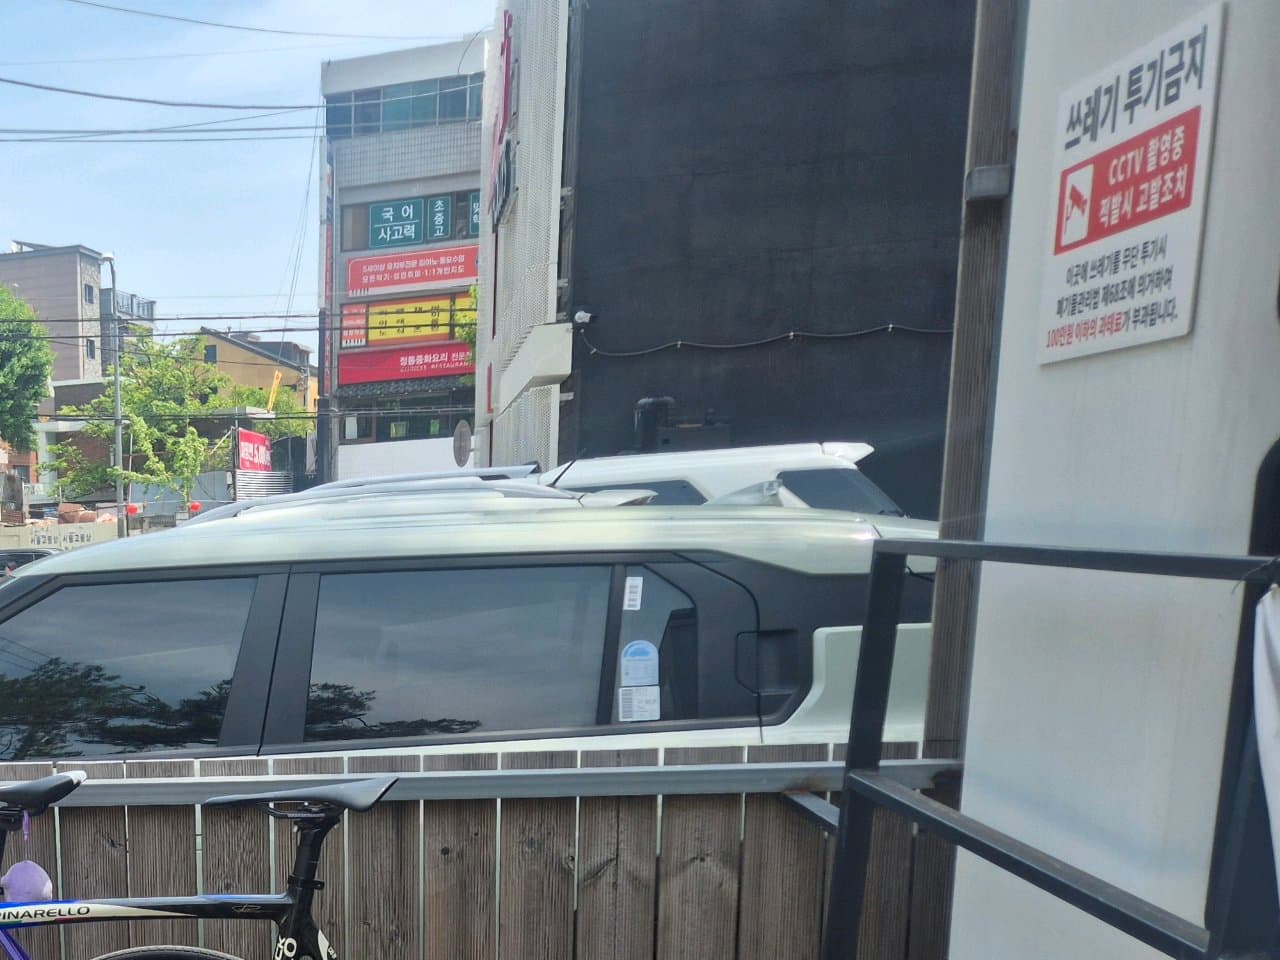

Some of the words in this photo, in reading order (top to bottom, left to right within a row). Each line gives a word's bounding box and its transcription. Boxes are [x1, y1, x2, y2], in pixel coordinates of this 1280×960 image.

[1064, 75, 1120, 150] 쓰레기
[1123, 24, 1208, 124] 투기금지
[1108, 147, 1145, 185] CCTV
[1146, 126, 1186, 171] 촬영중
[1099, 189, 1135, 228] 적발시
[1136, 164, 1189, 214] 고발조치
[378, 224, 416, 242] 사고력
[1090, 247, 1121, 280] 쓰레기를
[1122, 245, 1139, 273] 무단
[400, 351, 448, 369] 정통중화요리
